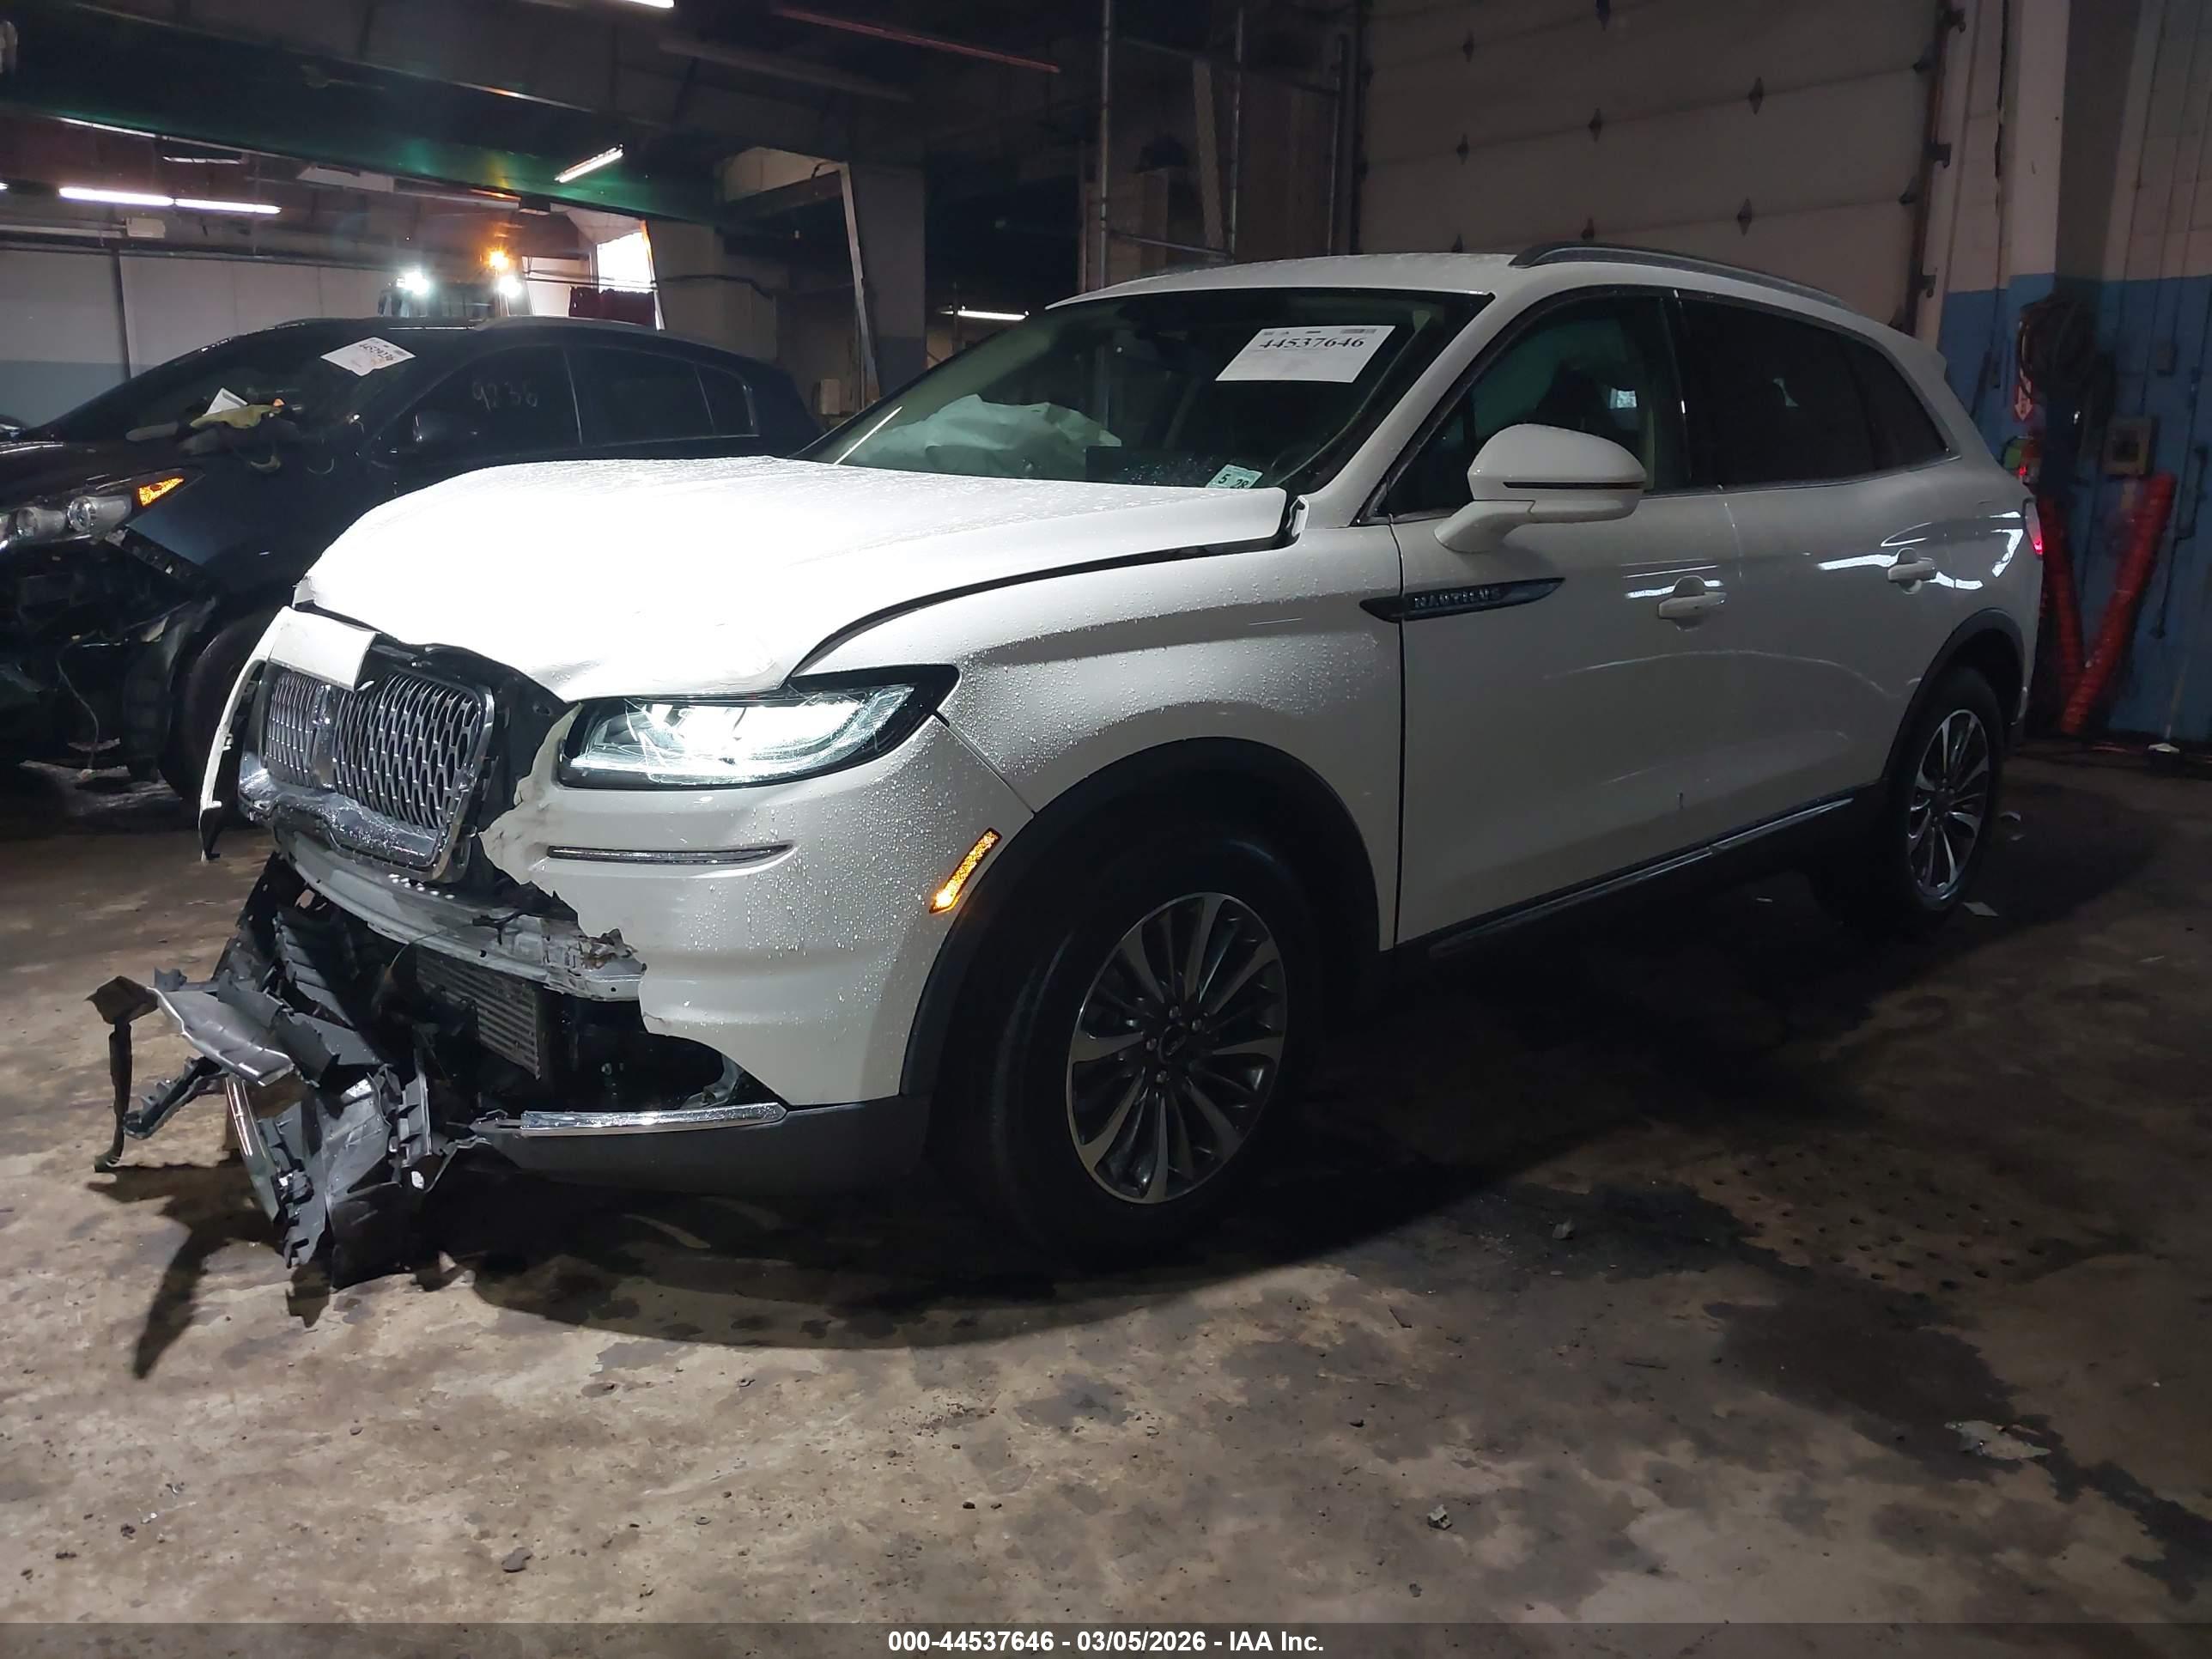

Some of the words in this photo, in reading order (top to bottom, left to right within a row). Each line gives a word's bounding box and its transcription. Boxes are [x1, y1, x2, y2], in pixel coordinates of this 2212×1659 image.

[1259, 337, 1365, 349] 44537646
[1218, 473, 1231, 484] 5
[1229, 478, 1249, 489] 28
[1414, 587, 1498, 609] NAUTILUS
